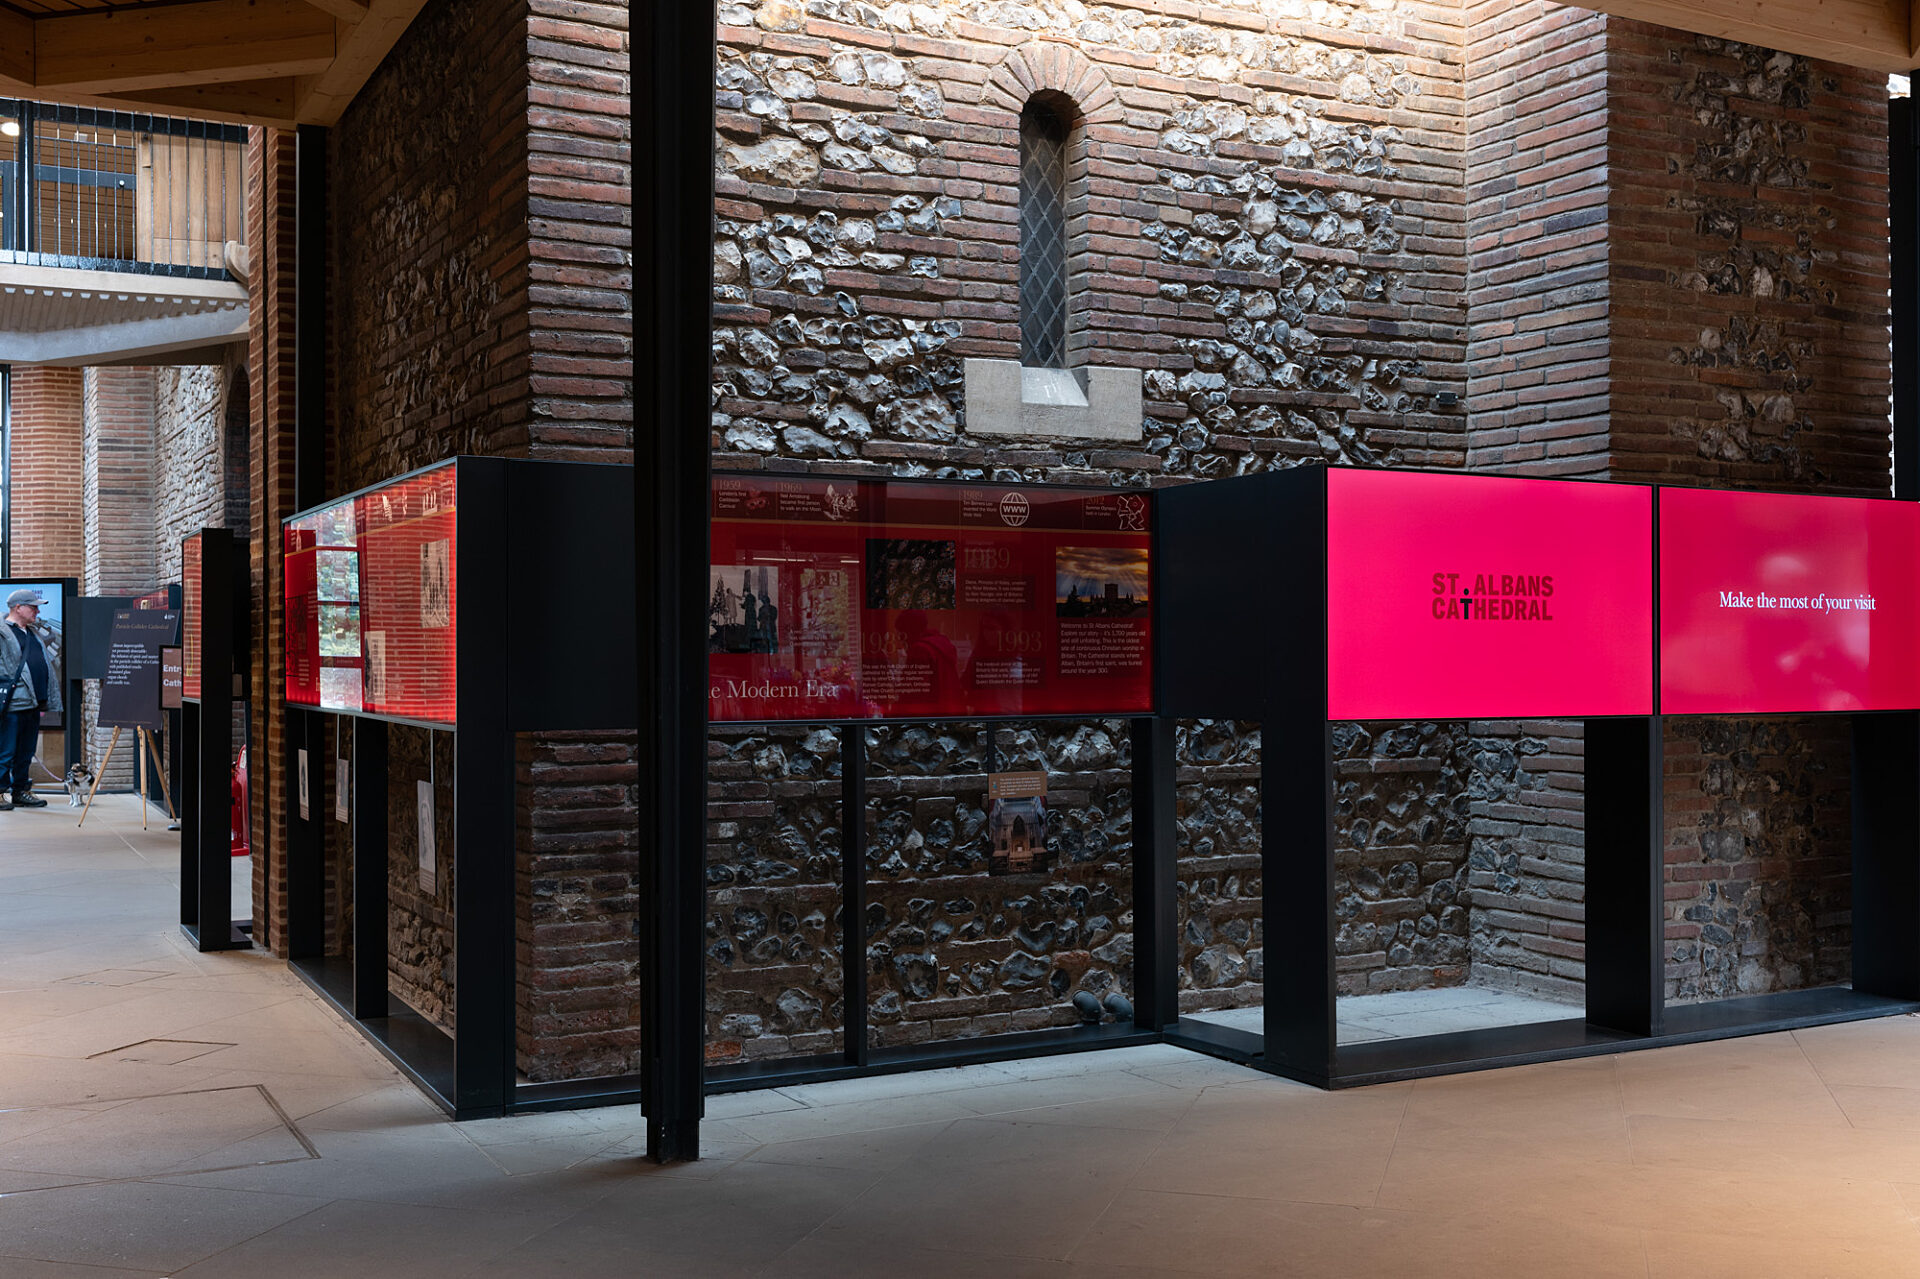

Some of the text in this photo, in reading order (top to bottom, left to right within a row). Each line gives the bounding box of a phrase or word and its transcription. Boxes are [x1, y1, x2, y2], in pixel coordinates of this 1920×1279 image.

[1474, 574, 1554, 597] ALBANS
[1432, 597, 1553, 621] CATHEDRAL
[1720, 591, 1876, 614] Make the most of your visit
[997, 630, 1042, 652] 1993
[726, 680, 799, 698] Modern
[806, 679, 839, 698] Era
